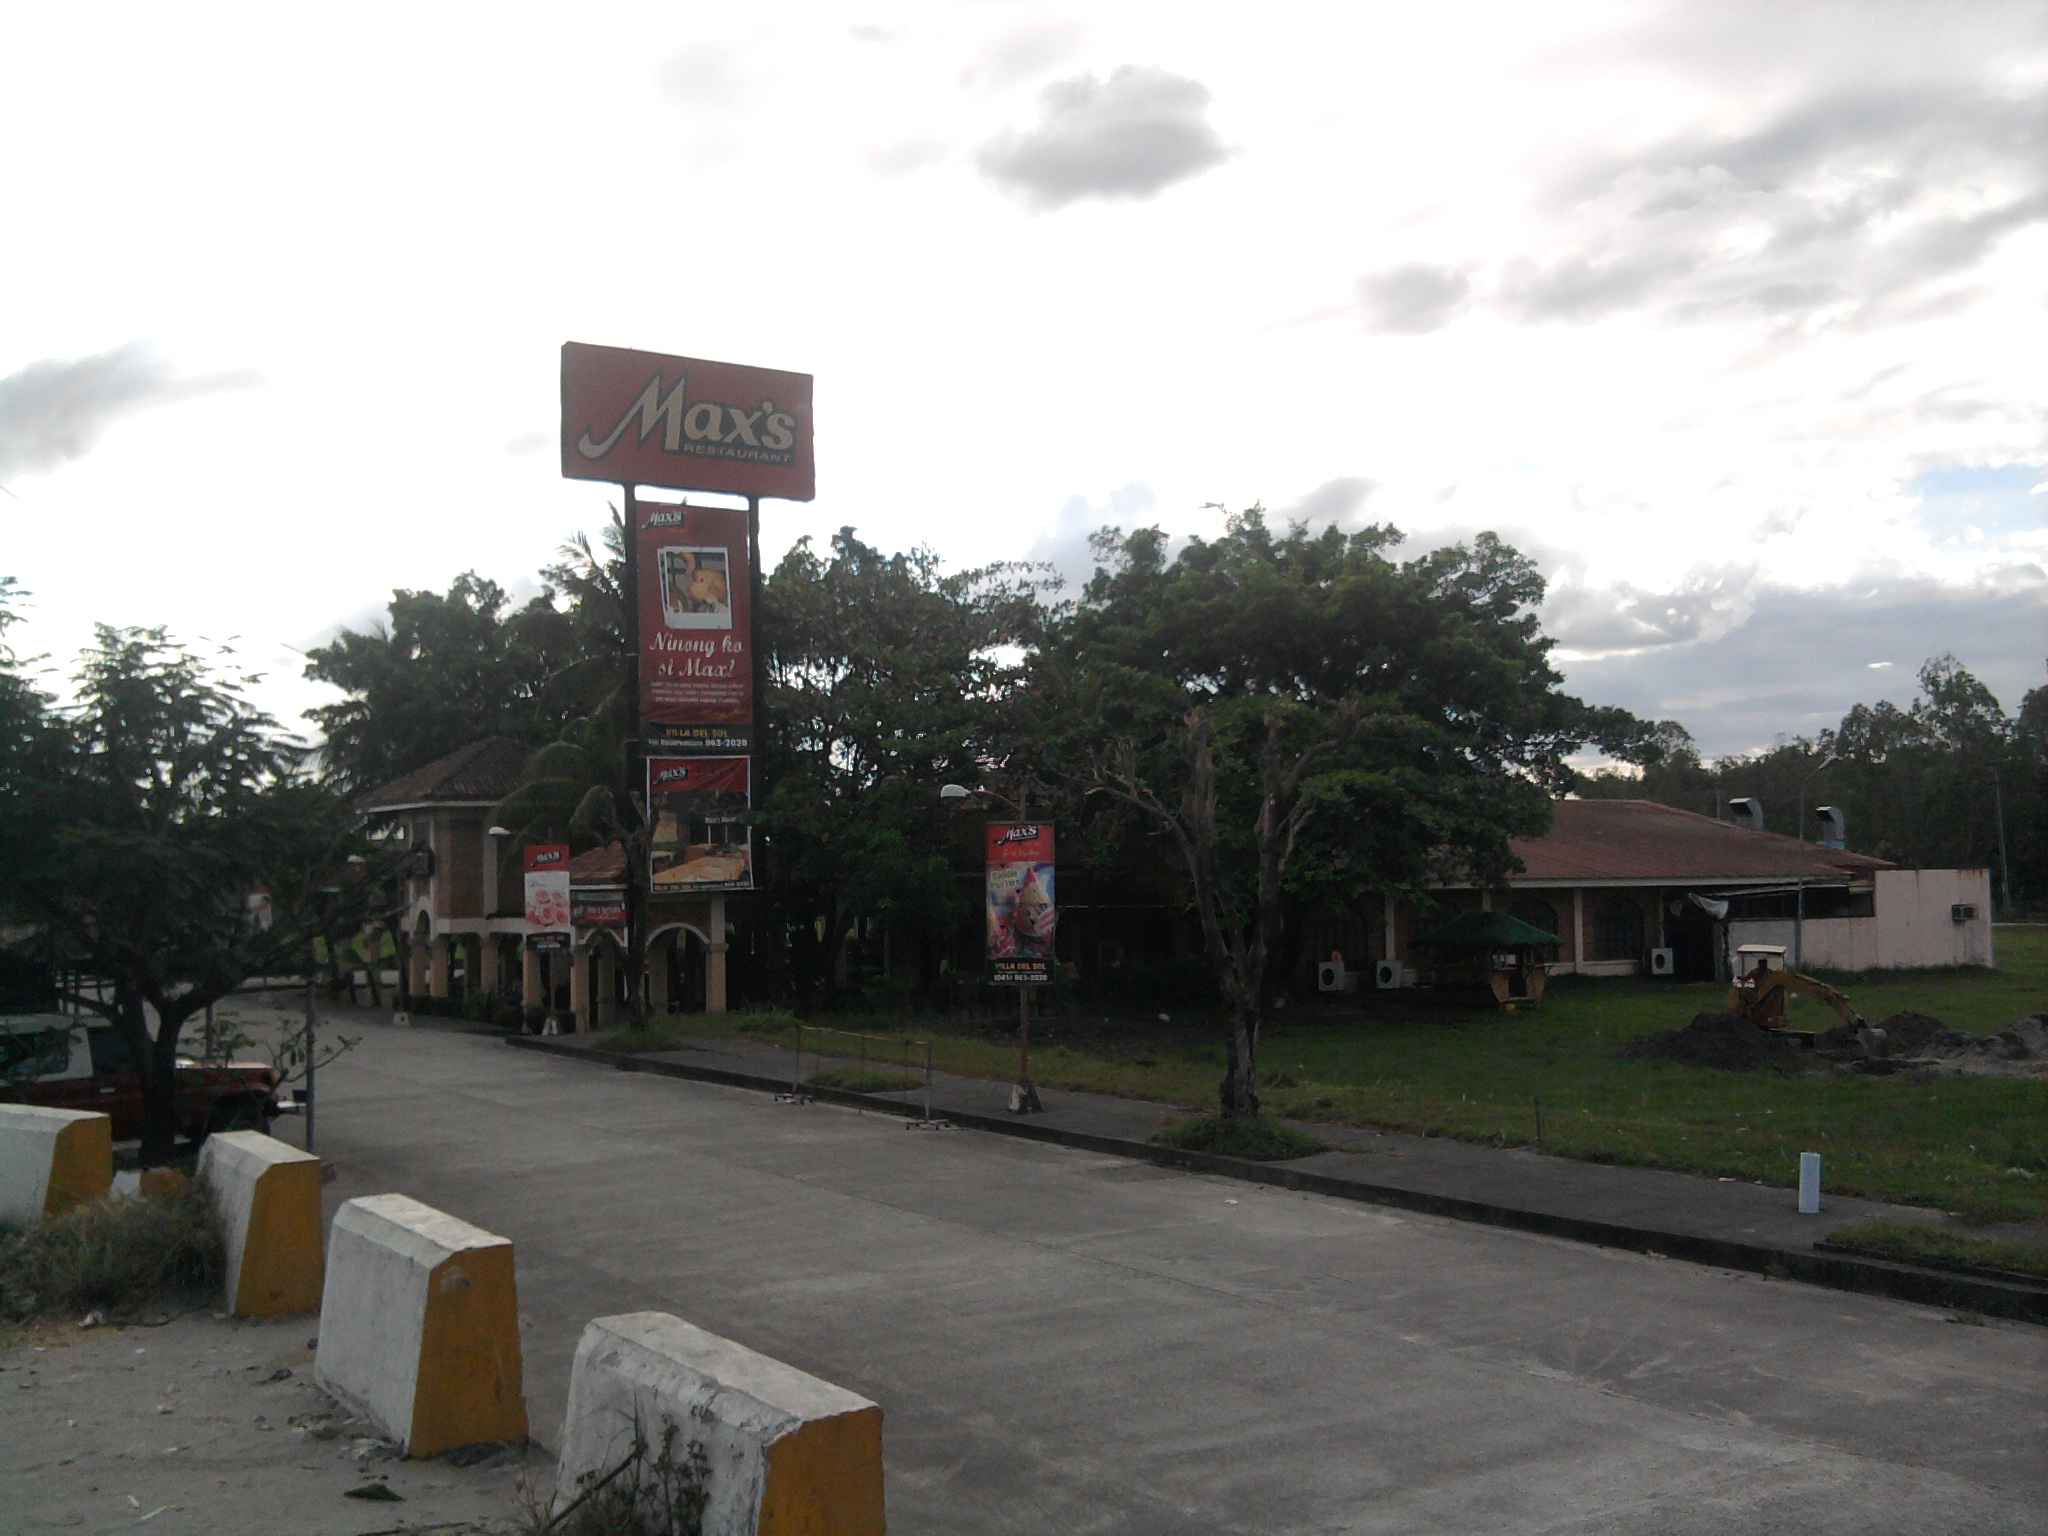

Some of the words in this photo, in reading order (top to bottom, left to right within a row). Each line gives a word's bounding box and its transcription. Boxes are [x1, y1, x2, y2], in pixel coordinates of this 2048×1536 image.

[577, 373, 796, 459] Max's
[682, 442, 793, 464] RESTAURANT
[650, 631, 716, 658] Ninong
[679, 658, 736, 678] Max!
[997, 824, 1037, 845] Max's
